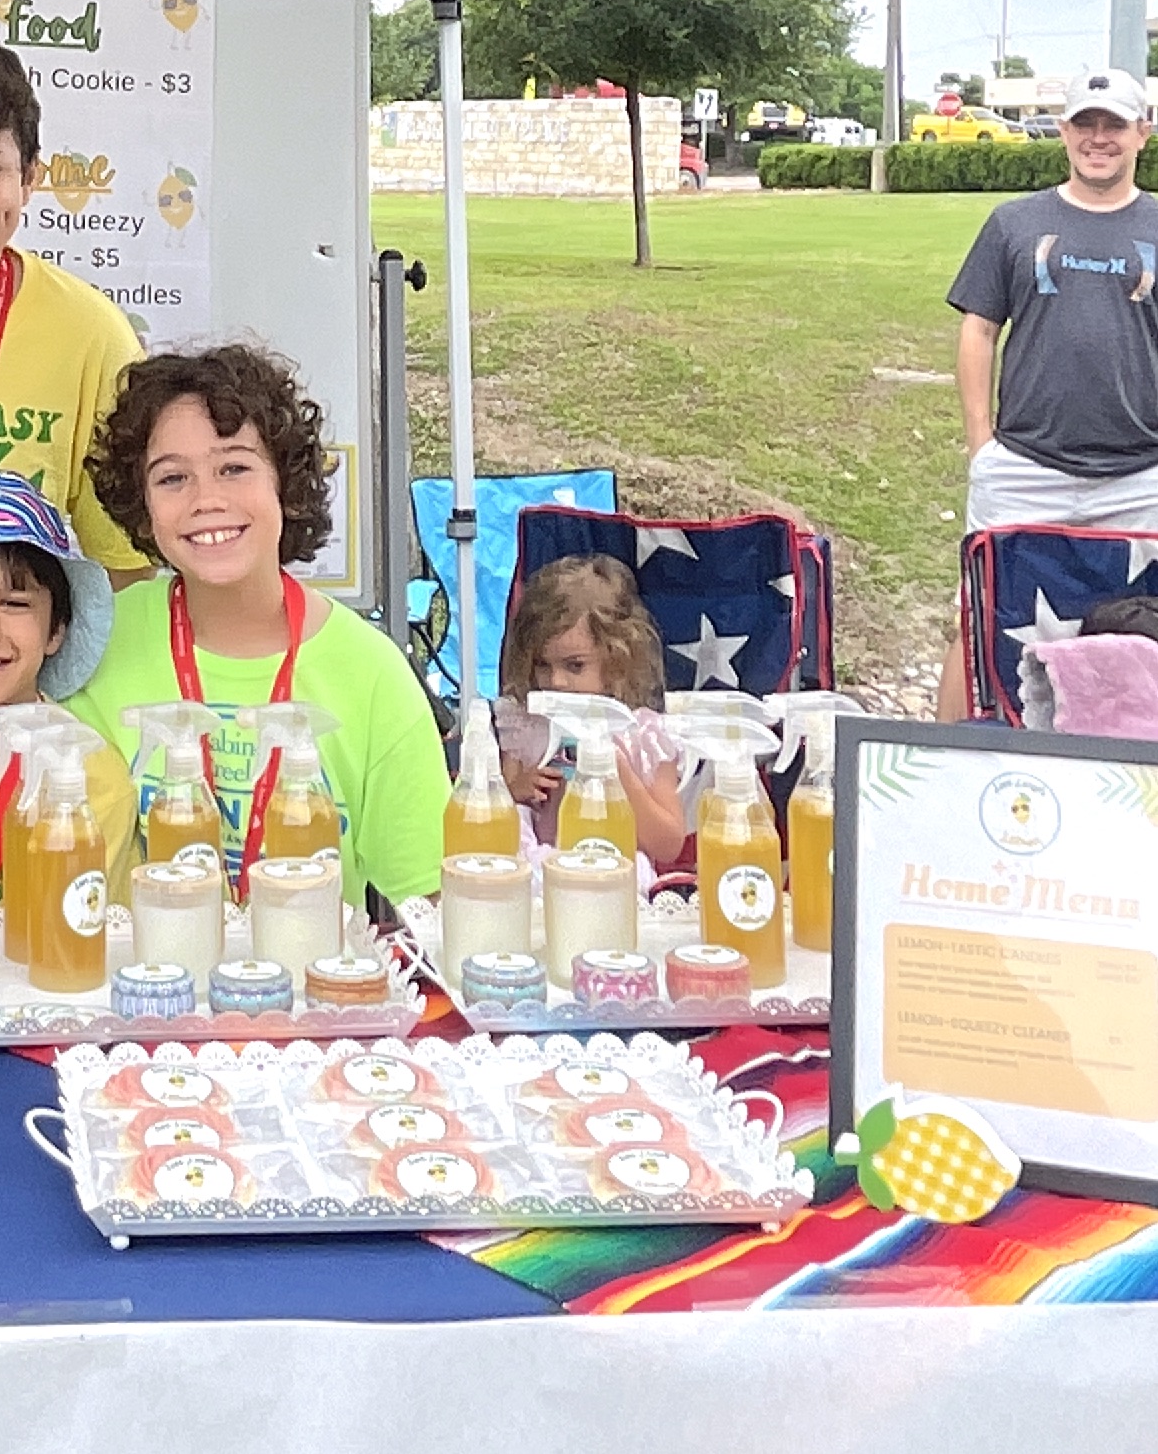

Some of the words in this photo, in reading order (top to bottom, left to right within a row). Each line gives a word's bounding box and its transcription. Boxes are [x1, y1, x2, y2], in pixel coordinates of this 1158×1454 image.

[52, 68, 136, 92] Cookie
[161, 72, 192, 95] $3
[39, 208, 145, 237] Squeezy
[92, 247, 120, 269] $5
[91, 284, 182, 306] andles
[902, 862, 1011, 907] Home
[1021, 873, 1140, 919] Menu
